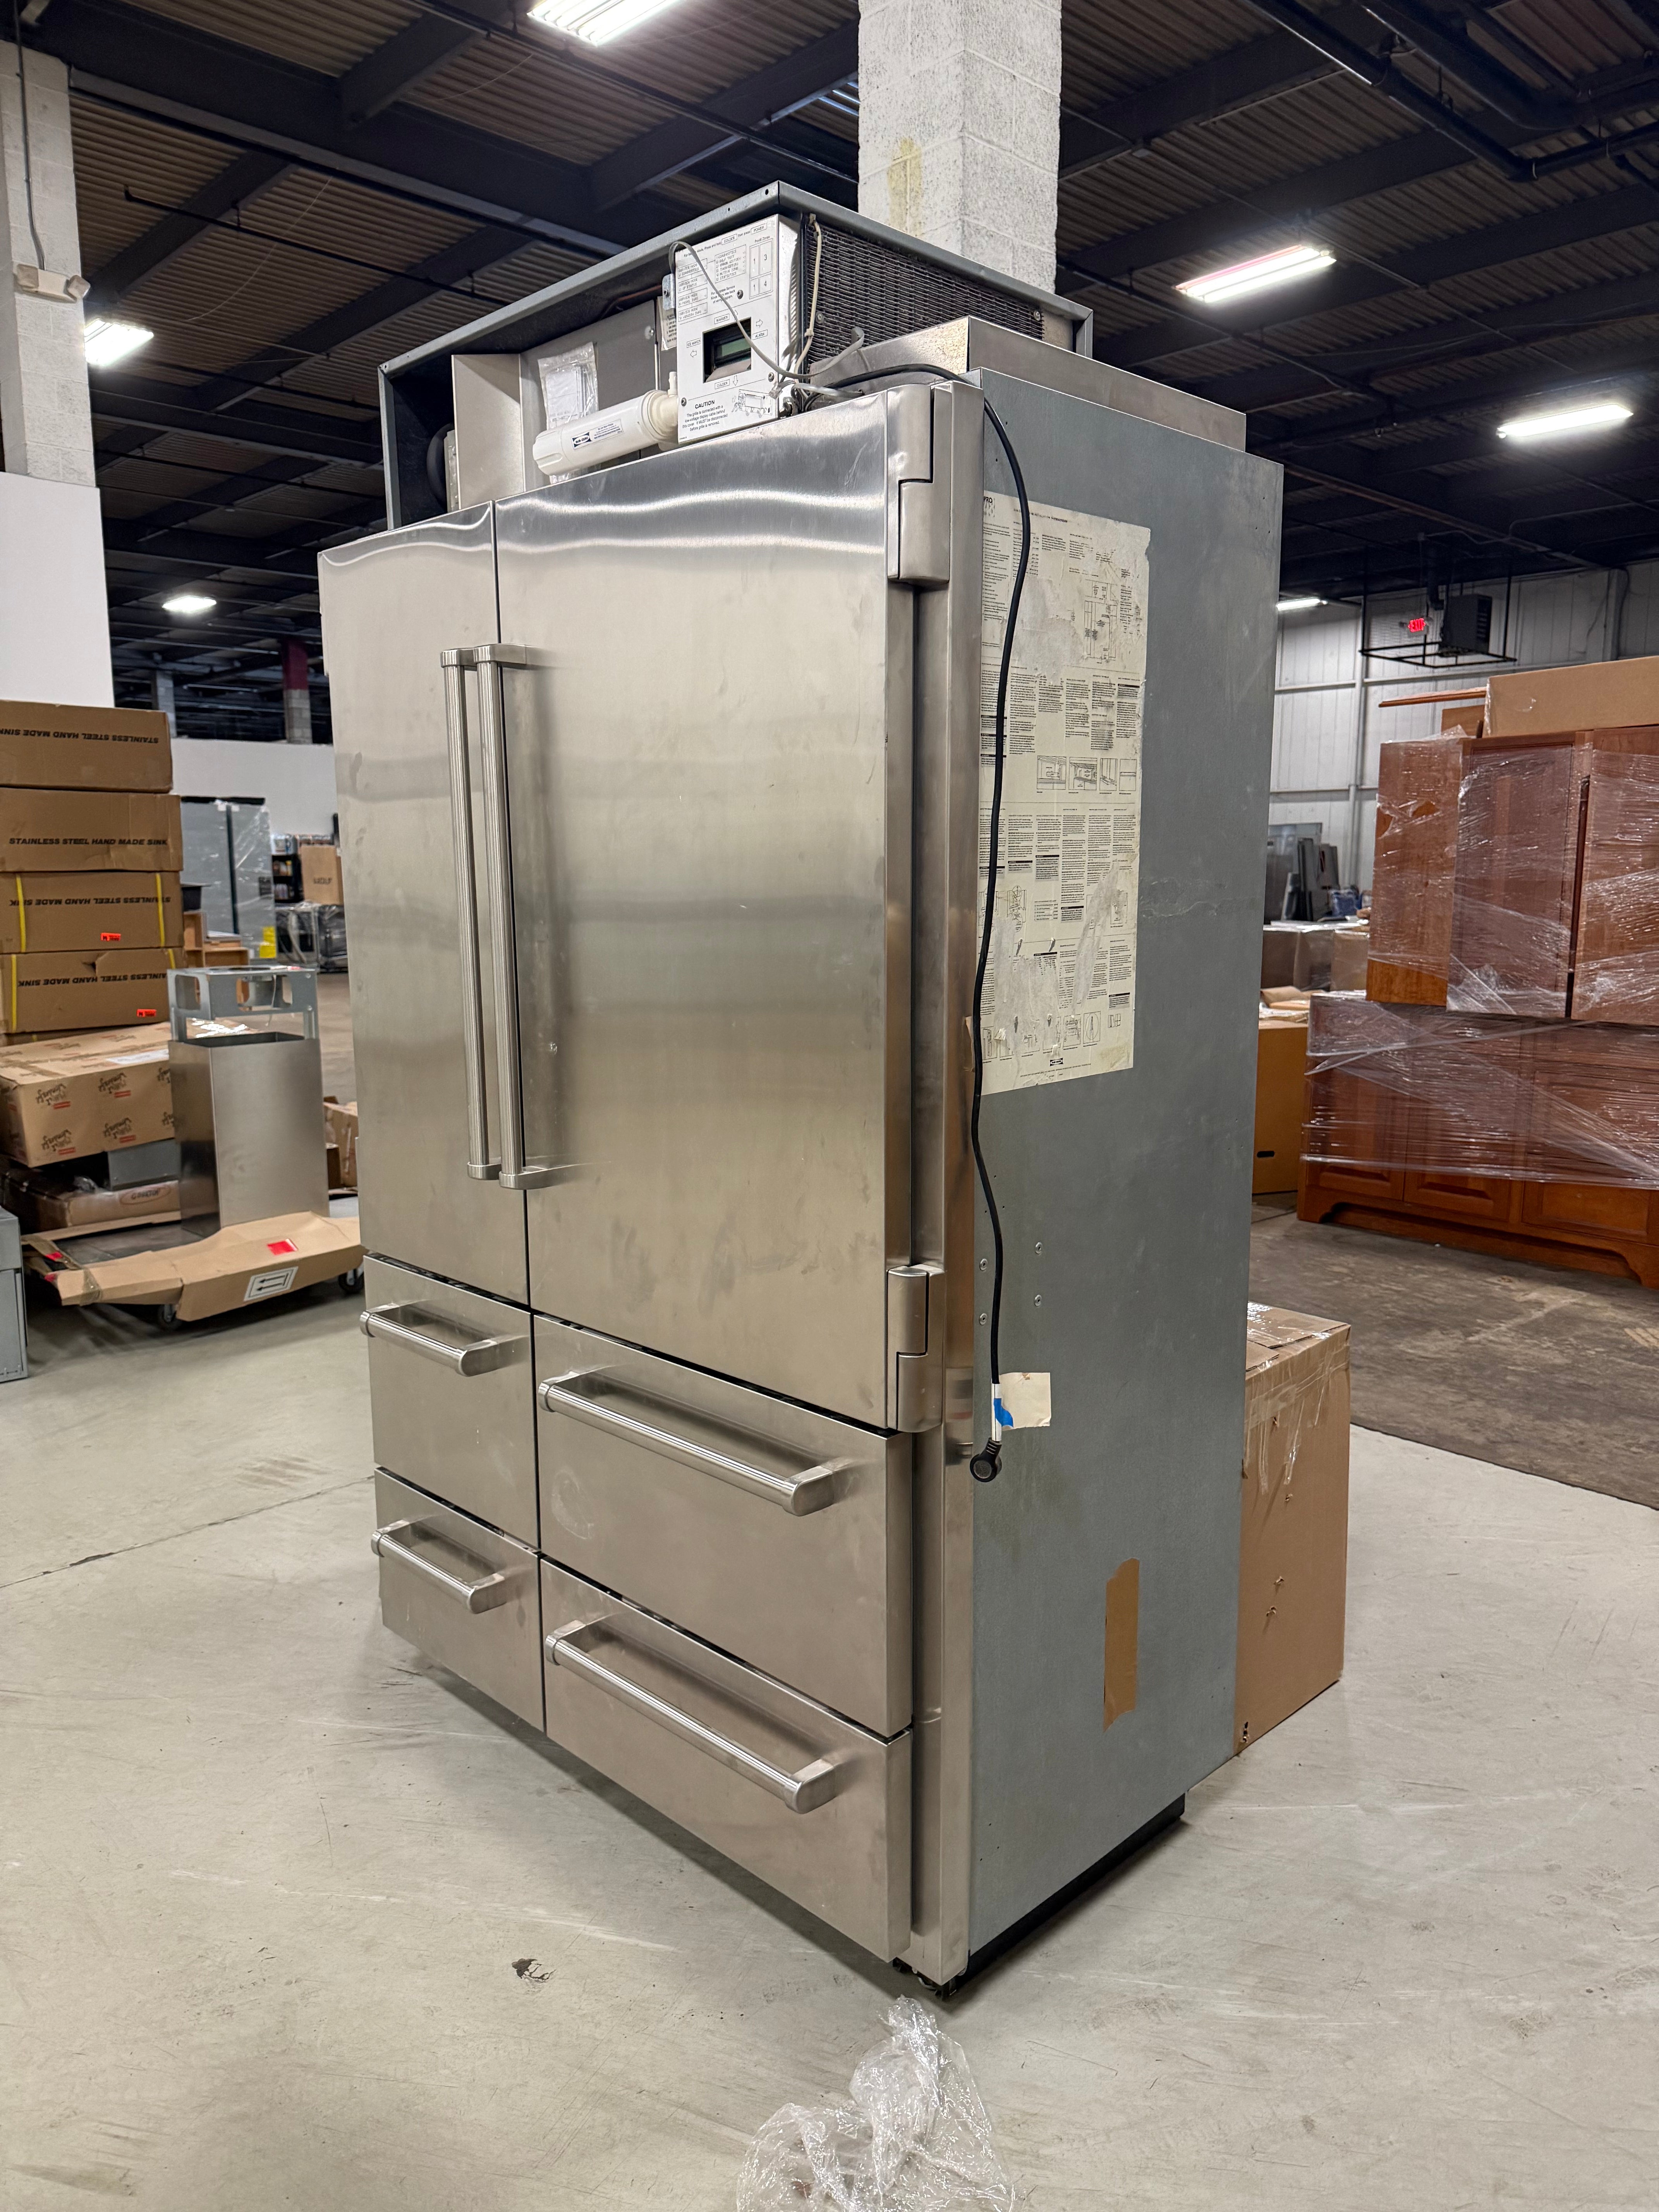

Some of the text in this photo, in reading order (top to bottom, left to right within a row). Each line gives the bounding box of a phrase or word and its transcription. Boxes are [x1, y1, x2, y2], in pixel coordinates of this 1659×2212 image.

[695, 400, 715, 409] CAUTION
[1410, 618, 1424, 632] EXIT
[53, 730, 79, 739] HAND
[81, 733, 109, 741] STEEL
[112, 734, 158, 744] STAINLESS
[100, 974, 128, 982] STEEL
[18, 979, 41, 987] SINK
